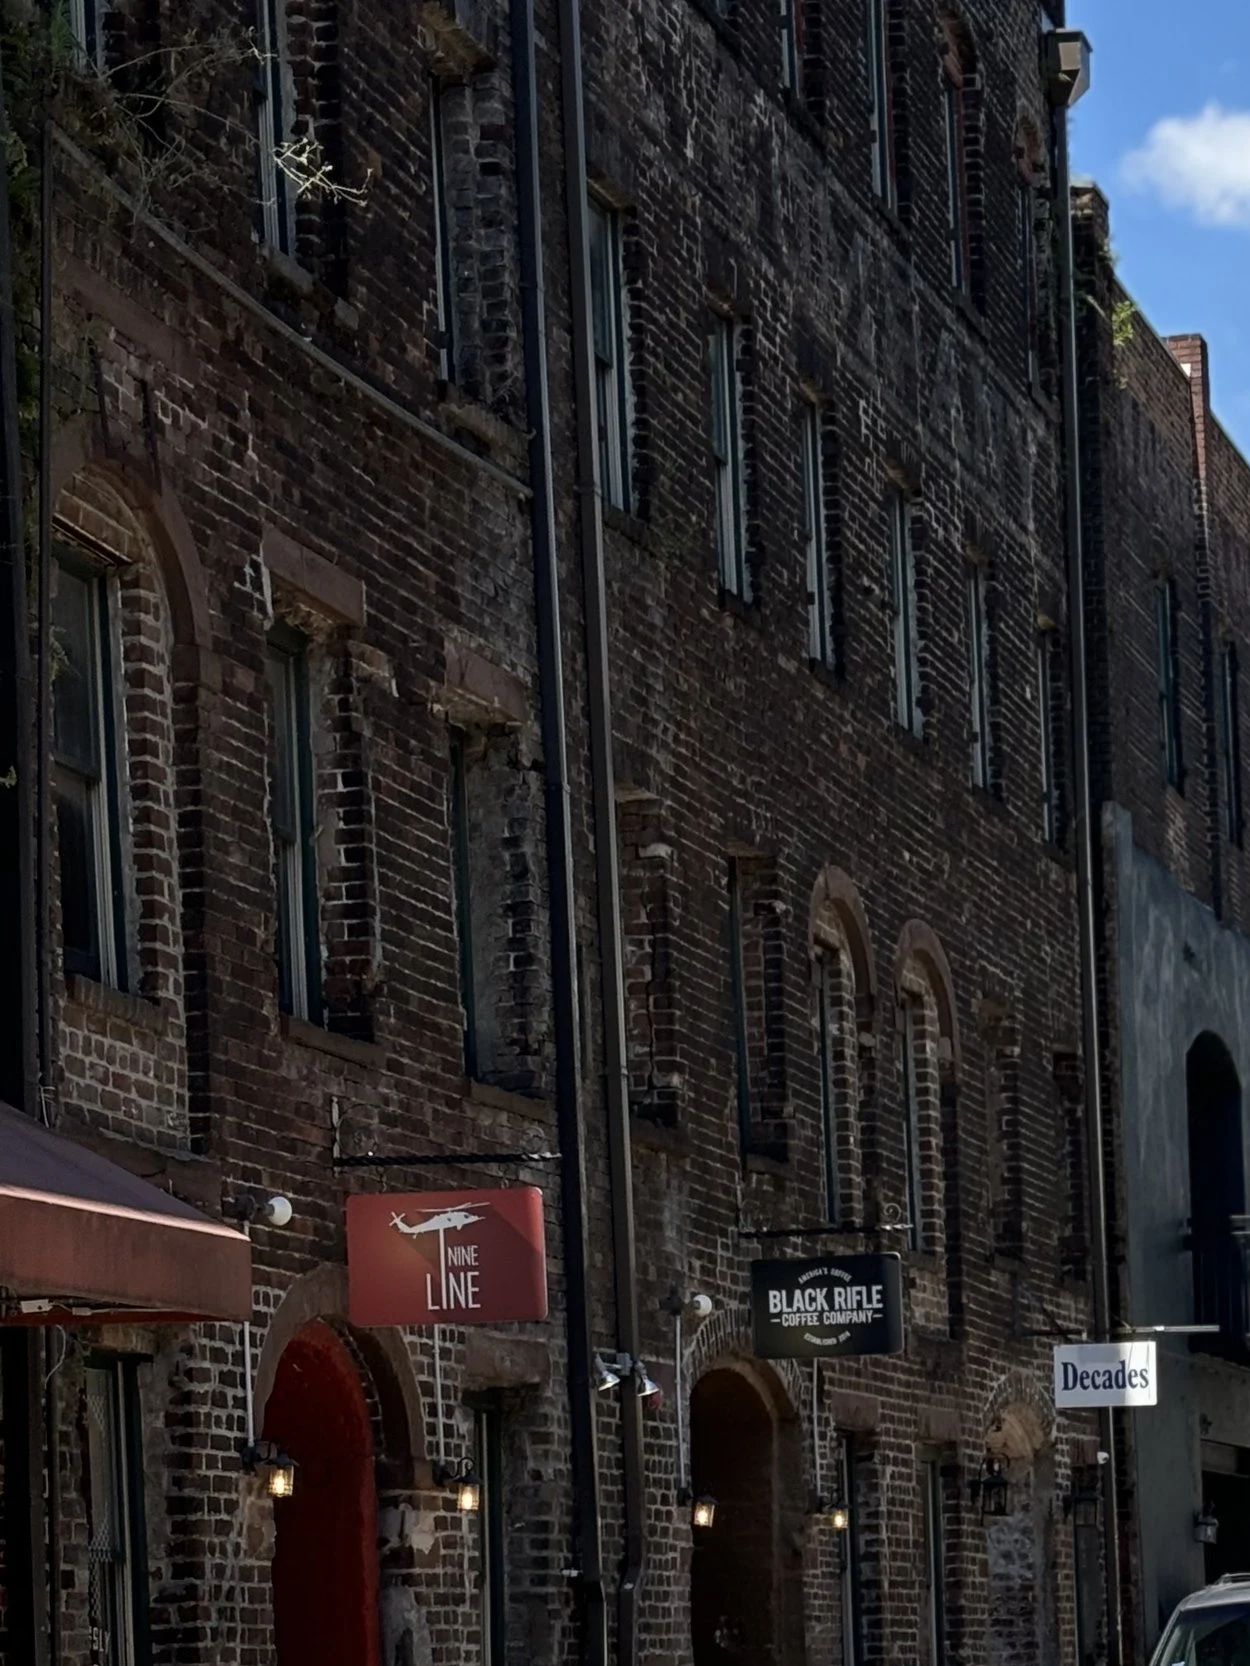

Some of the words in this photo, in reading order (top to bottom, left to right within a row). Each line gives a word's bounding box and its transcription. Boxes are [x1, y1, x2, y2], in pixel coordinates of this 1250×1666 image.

[447, 1245, 479, 1267] NINE
[426, 1271, 481, 1311] LINE
[768, 1287, 830, 1313] BLACK
[834, 1285, 883, 1310] RIFLE
[782, 1312, 819, 1327] COFFEE
[823, 1310, 873, 1325] COMPANY
[1061, 1360, 1149, 1391] Decades
